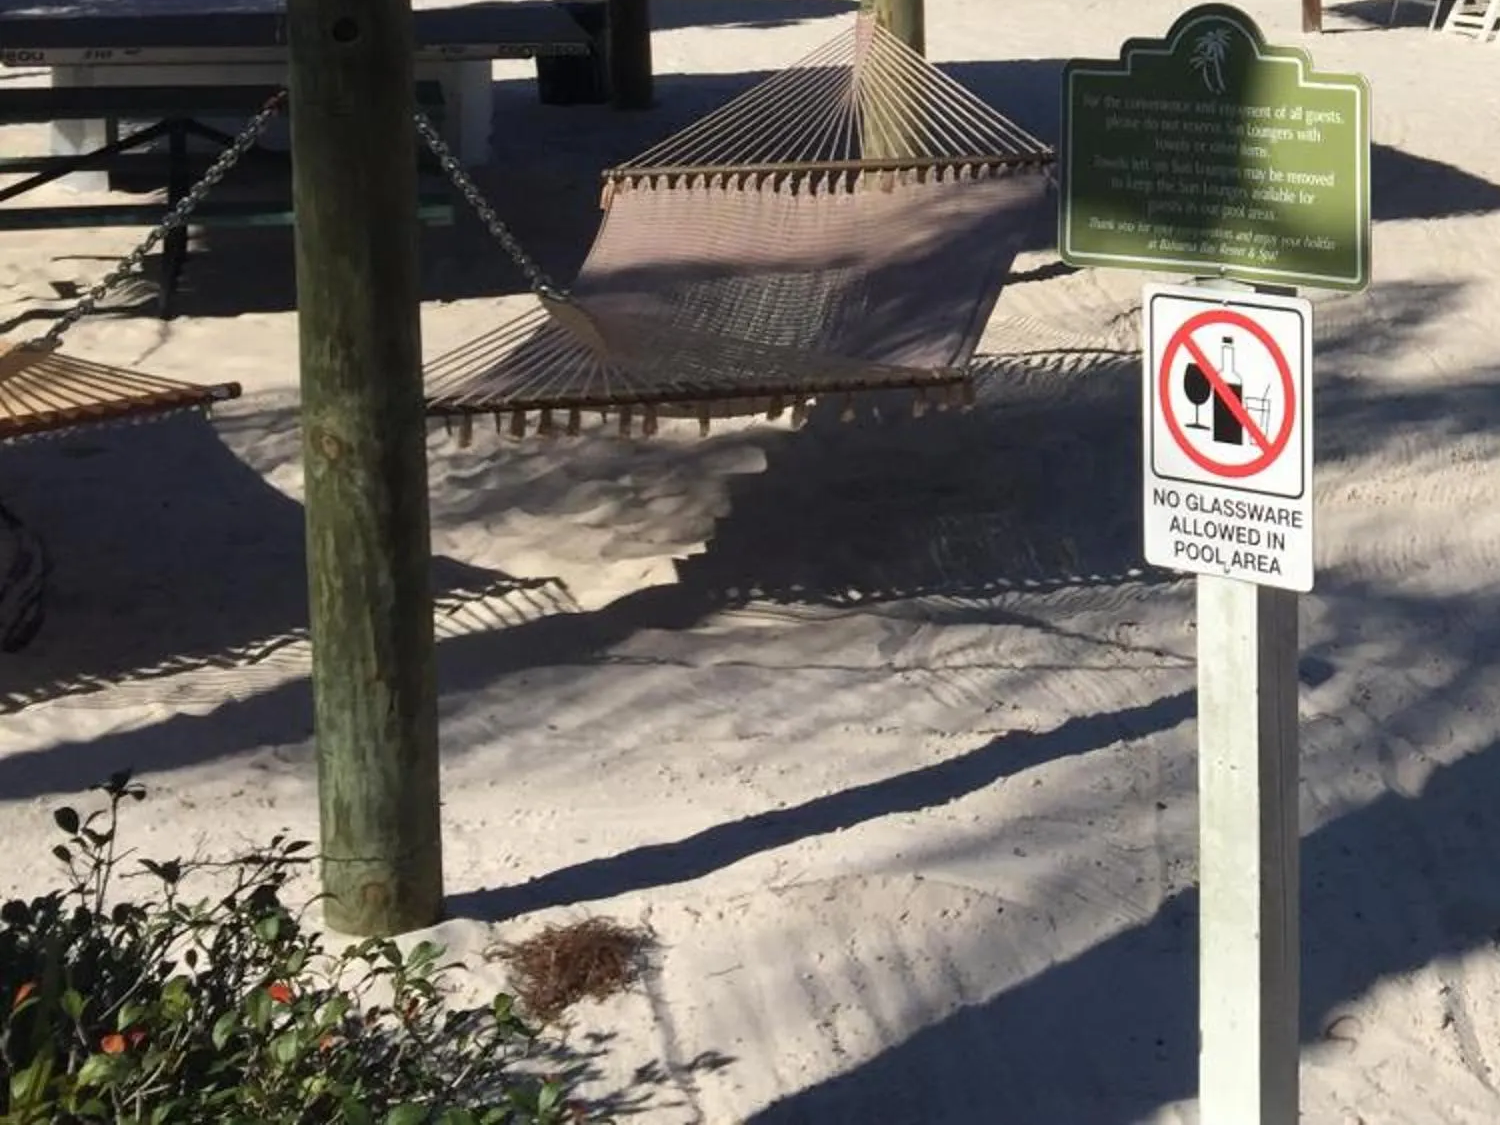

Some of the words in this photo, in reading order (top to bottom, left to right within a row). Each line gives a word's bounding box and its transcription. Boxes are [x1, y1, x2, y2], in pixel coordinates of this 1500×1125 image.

[1290, 106, 1302, 120] all
[1269, 166, 1284, 182] be
[1153, 488, 1180, 508] NO
[1186, 493, 1303, 529] GLASSWARE
[1169, 515, 1261, 546] ALLOWED
[1267, 529, 1285, 551] IN
[1174, 541, 1224, 566] POOL
[1231, 550, 1281, 576] AREA
